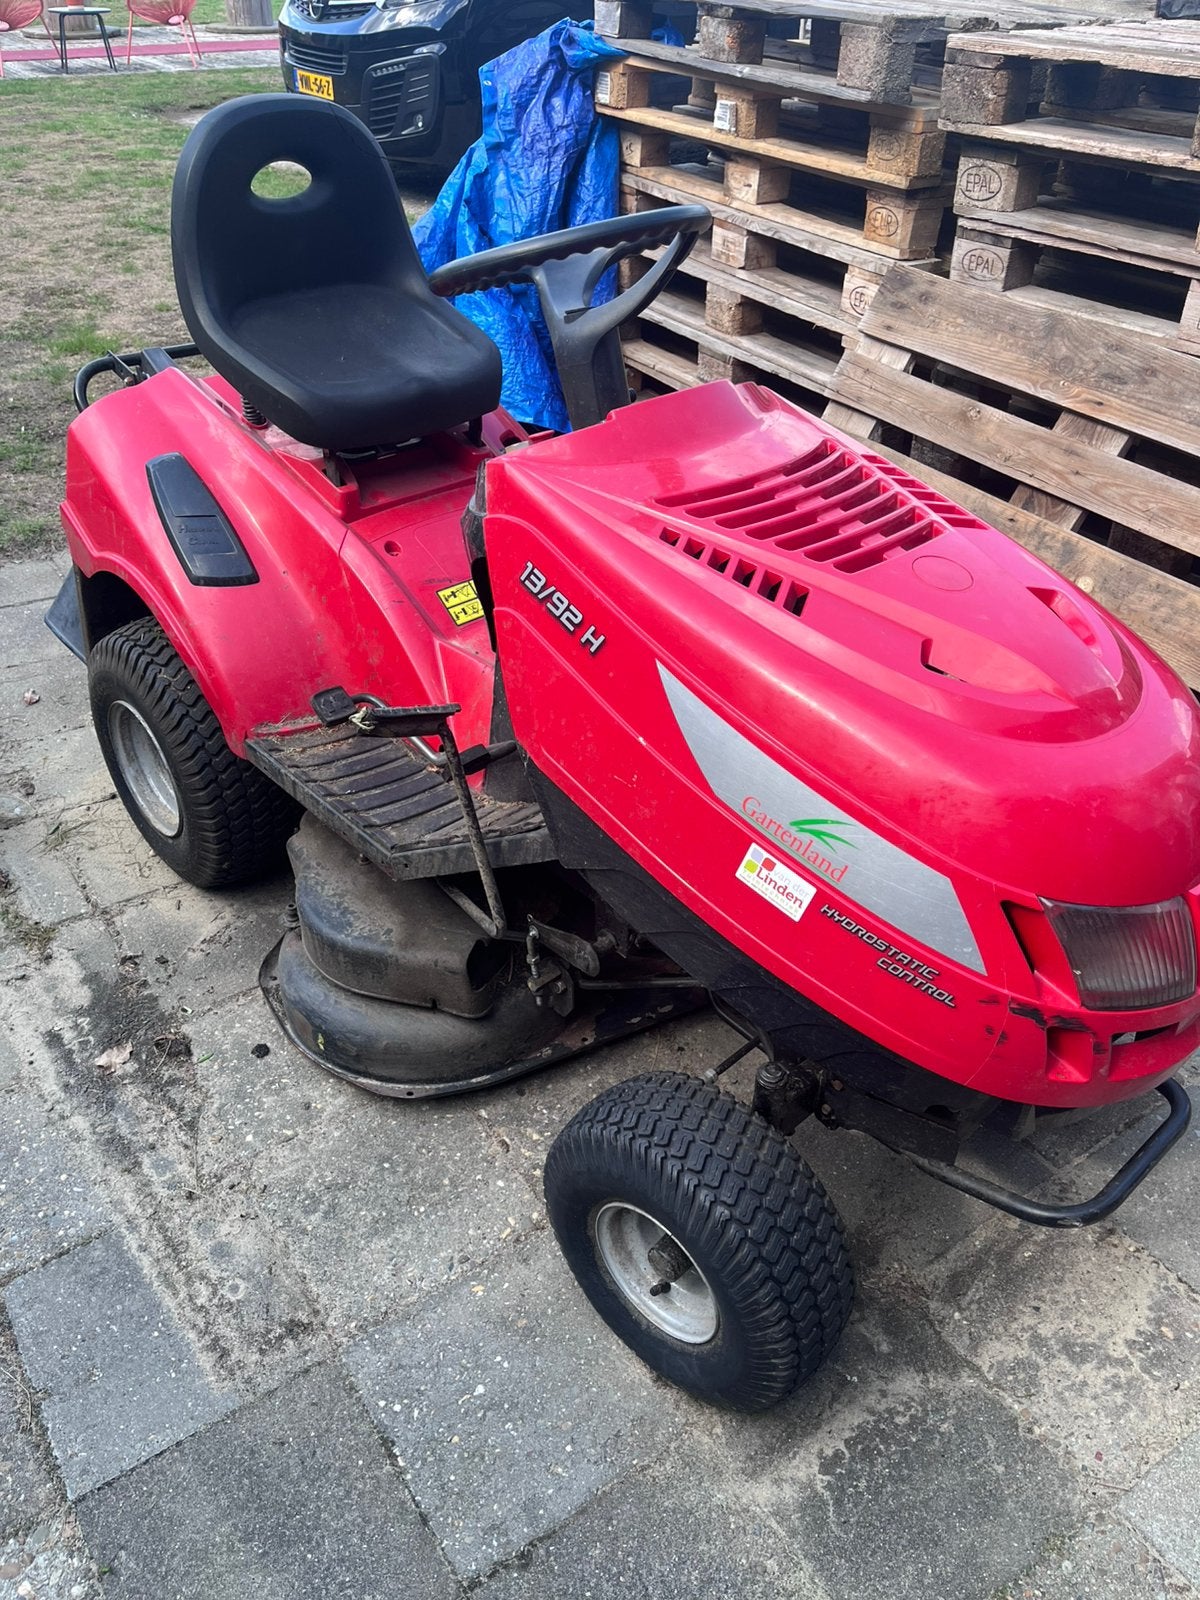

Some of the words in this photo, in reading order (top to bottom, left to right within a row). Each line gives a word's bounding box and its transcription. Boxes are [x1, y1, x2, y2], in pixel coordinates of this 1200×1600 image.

[965, 172, 995, 194] EPAL
[968, 254, 996, 277] EPAL
[519, 560, 584, 633] 13/92
[580, 625, 606, 654] H
[741, 796, 849, 883] Gartenland
[756, 866, 804, 909] Linden
[819, 903, 940, 980] HYDROSTATIC
[876, 956, 956, 1008] CONTROL
